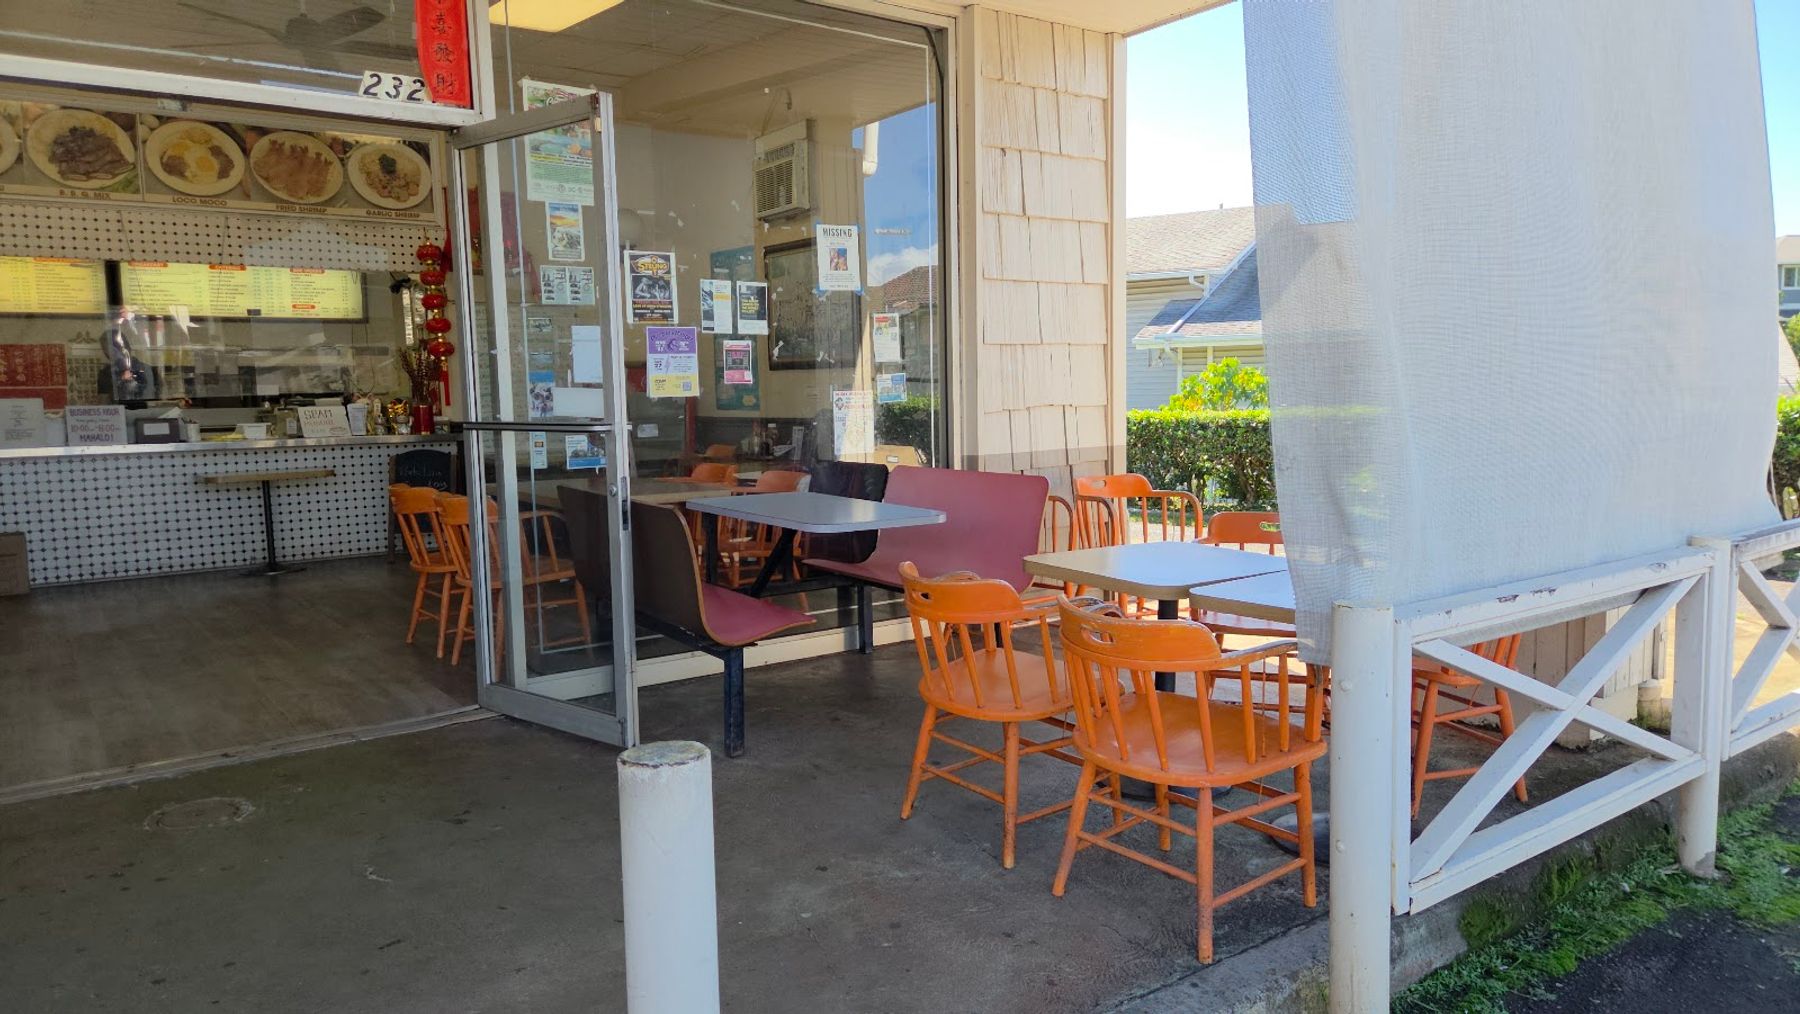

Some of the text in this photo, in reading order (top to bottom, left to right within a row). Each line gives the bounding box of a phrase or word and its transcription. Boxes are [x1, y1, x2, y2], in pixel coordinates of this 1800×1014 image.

[362, 73, 425, 101] 232
[172, 196, 227, 207] LOCO MOCO
[275, 204, 327, 214] FRIED SHRIMP
[366, 209, 420, 219] GARLIC SHRIMP
[822, 227, 853, 238] MISSING
[69, 408, 120, 417] BUSINESS HOUR
[303, 409, 333, 420] SPAM
